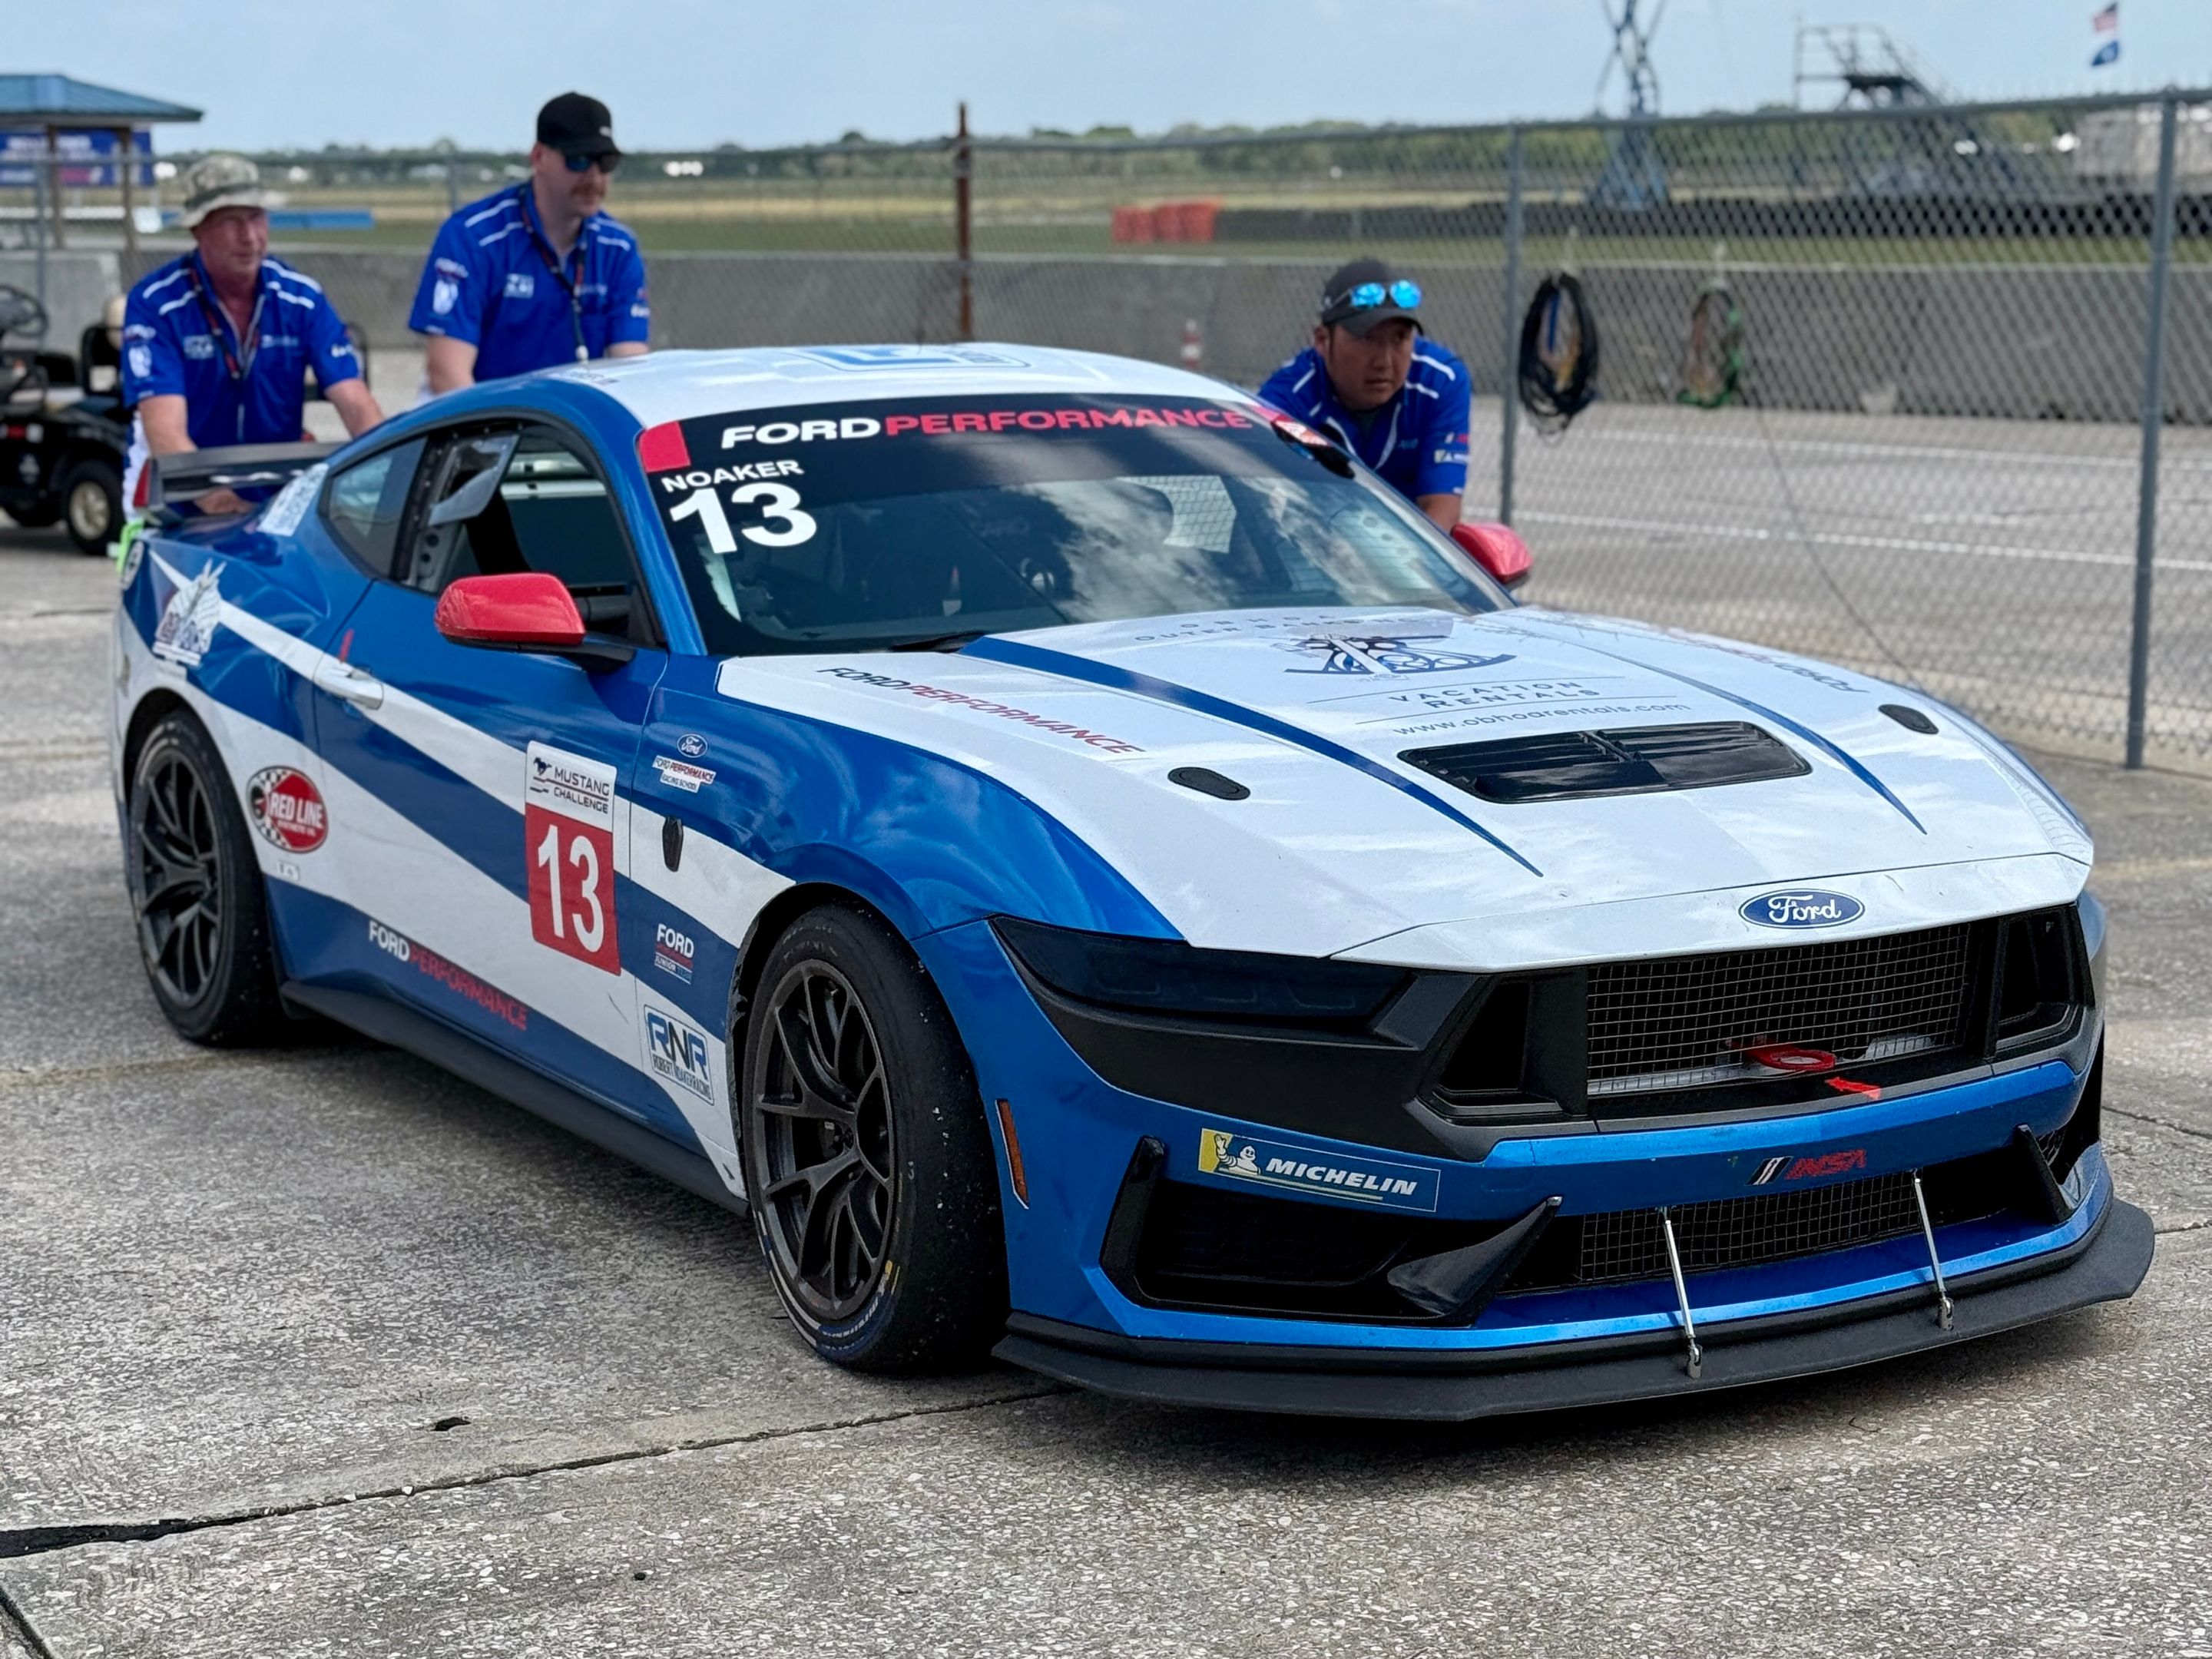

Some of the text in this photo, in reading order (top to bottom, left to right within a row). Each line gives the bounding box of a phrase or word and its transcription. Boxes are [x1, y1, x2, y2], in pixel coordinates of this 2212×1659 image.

[720, 417, 882, 449] FORD
[885, 409, 1253, 437] PERFORMANCE
[661, 459, 805, 493] NOAKER
[668, 482, 818, 555] 13
[1389, 682, 1584, 703] VACATION
[1424, 689, 1601, 709] RENTALS
[816, 667, 1147, 754] FORD PERFORMANCE
[1392, 704, 1692, 735] www.obhoarentals.com
[680, 736, 704, 755] Ford
[554, 767, 610, 796] MUSTANG
[670, 762, 714, 783] PERFORMANCE
[269, 791, 324, 830] RED LINE
[553, 786, 609, 814] CHALLENGE
[538, 823, 605, 953] 13
[1767, 893, 1843, 924] Ford
[657, 922, 694, 959] FORD
[369, 920, 528, 1031] FORD PERFORMANCE
[647, 1012, 709, 1081] RNR
[1264, 1157, 1419, 1196] MICHELIN
